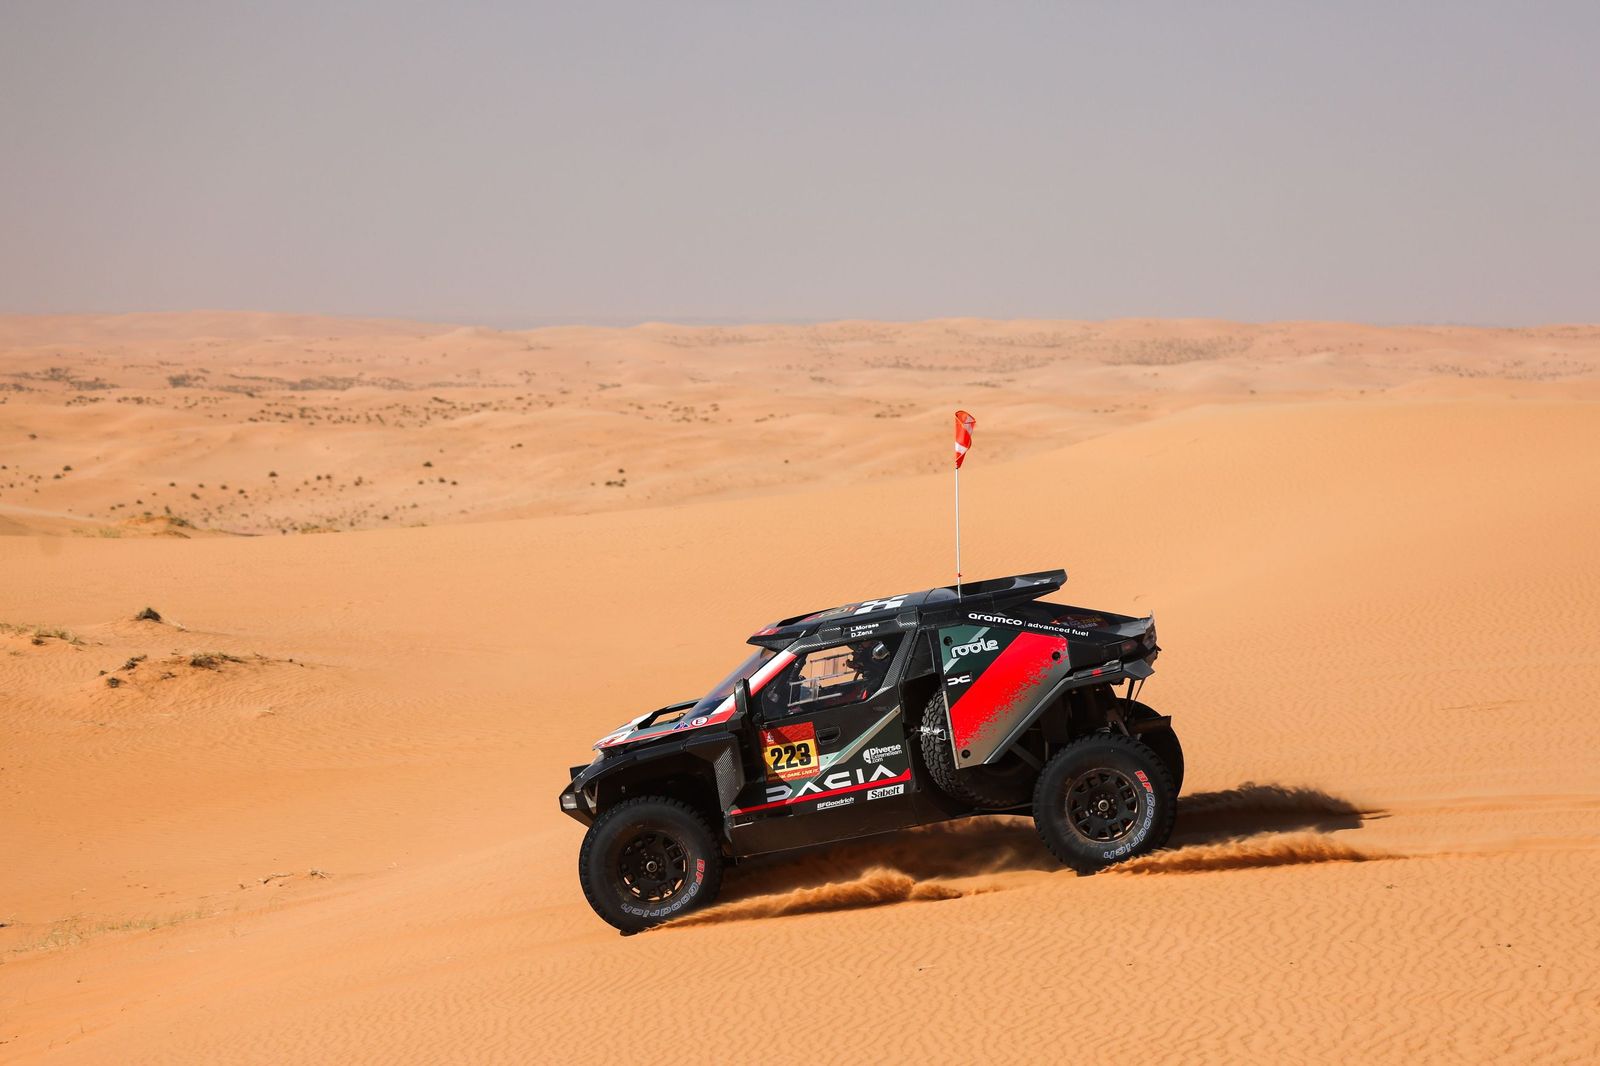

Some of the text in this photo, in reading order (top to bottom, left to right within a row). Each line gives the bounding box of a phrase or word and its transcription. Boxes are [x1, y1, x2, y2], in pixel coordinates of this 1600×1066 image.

[968, 612, 1023, 626] aramco
[1027, 622, 1070, 634] advanced
[1072, 629, 1089, 637] fuel
[951, 638, 999, 658] roole
[770, 742, 812, 771] 223
[870, 744, 902, 755] Diverse
[765, 764, 898, 803] DACIA
[871, 786, 900, 799] Sabelt
[816, 797, 855, 809] BFGoodrich
[1103, 770, 1156, 859] BFGoodrich
[620, 858, 706, 918] BFGoodrich
